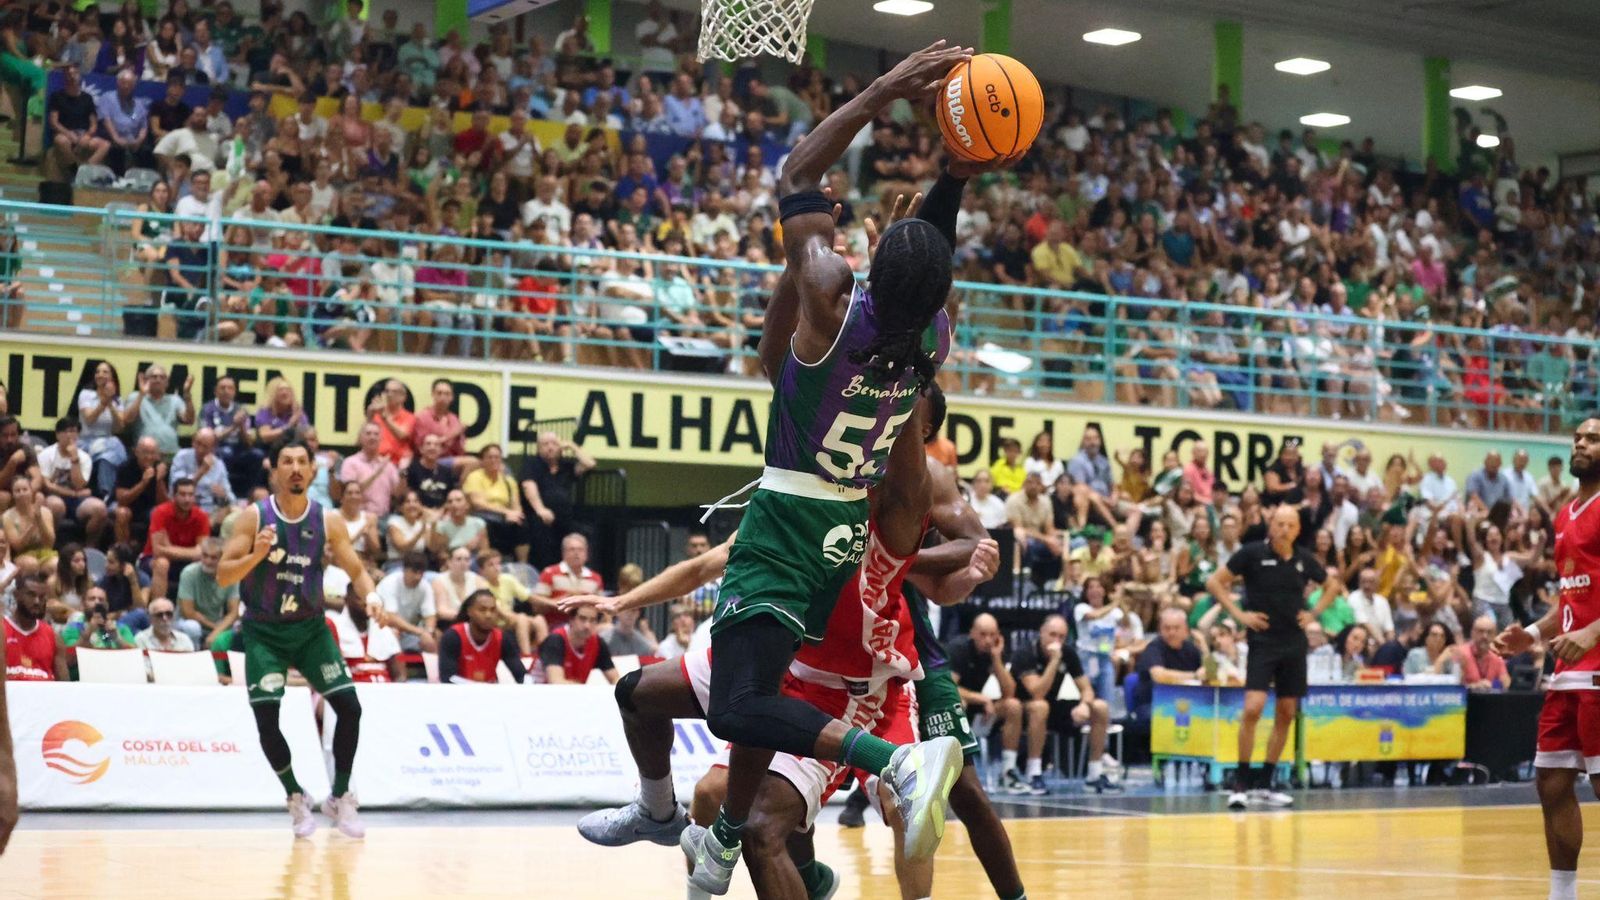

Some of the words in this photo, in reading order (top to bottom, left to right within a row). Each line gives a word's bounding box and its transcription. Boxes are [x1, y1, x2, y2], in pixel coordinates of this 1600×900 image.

[946, 75, 975, 149] Wilson
[985, 84, 1001, 113] acb
[841, 375, 920, 404] Benahav
[575, 390, 763, 454] ALHA
[815, 409, 917, 480] 55
[122, 740, 174, 752] COSTA
[178, 741, 206, 752] DEL
[211, 741, 240, 753] SOL
[527, 752, 623, 769] COMPITE
